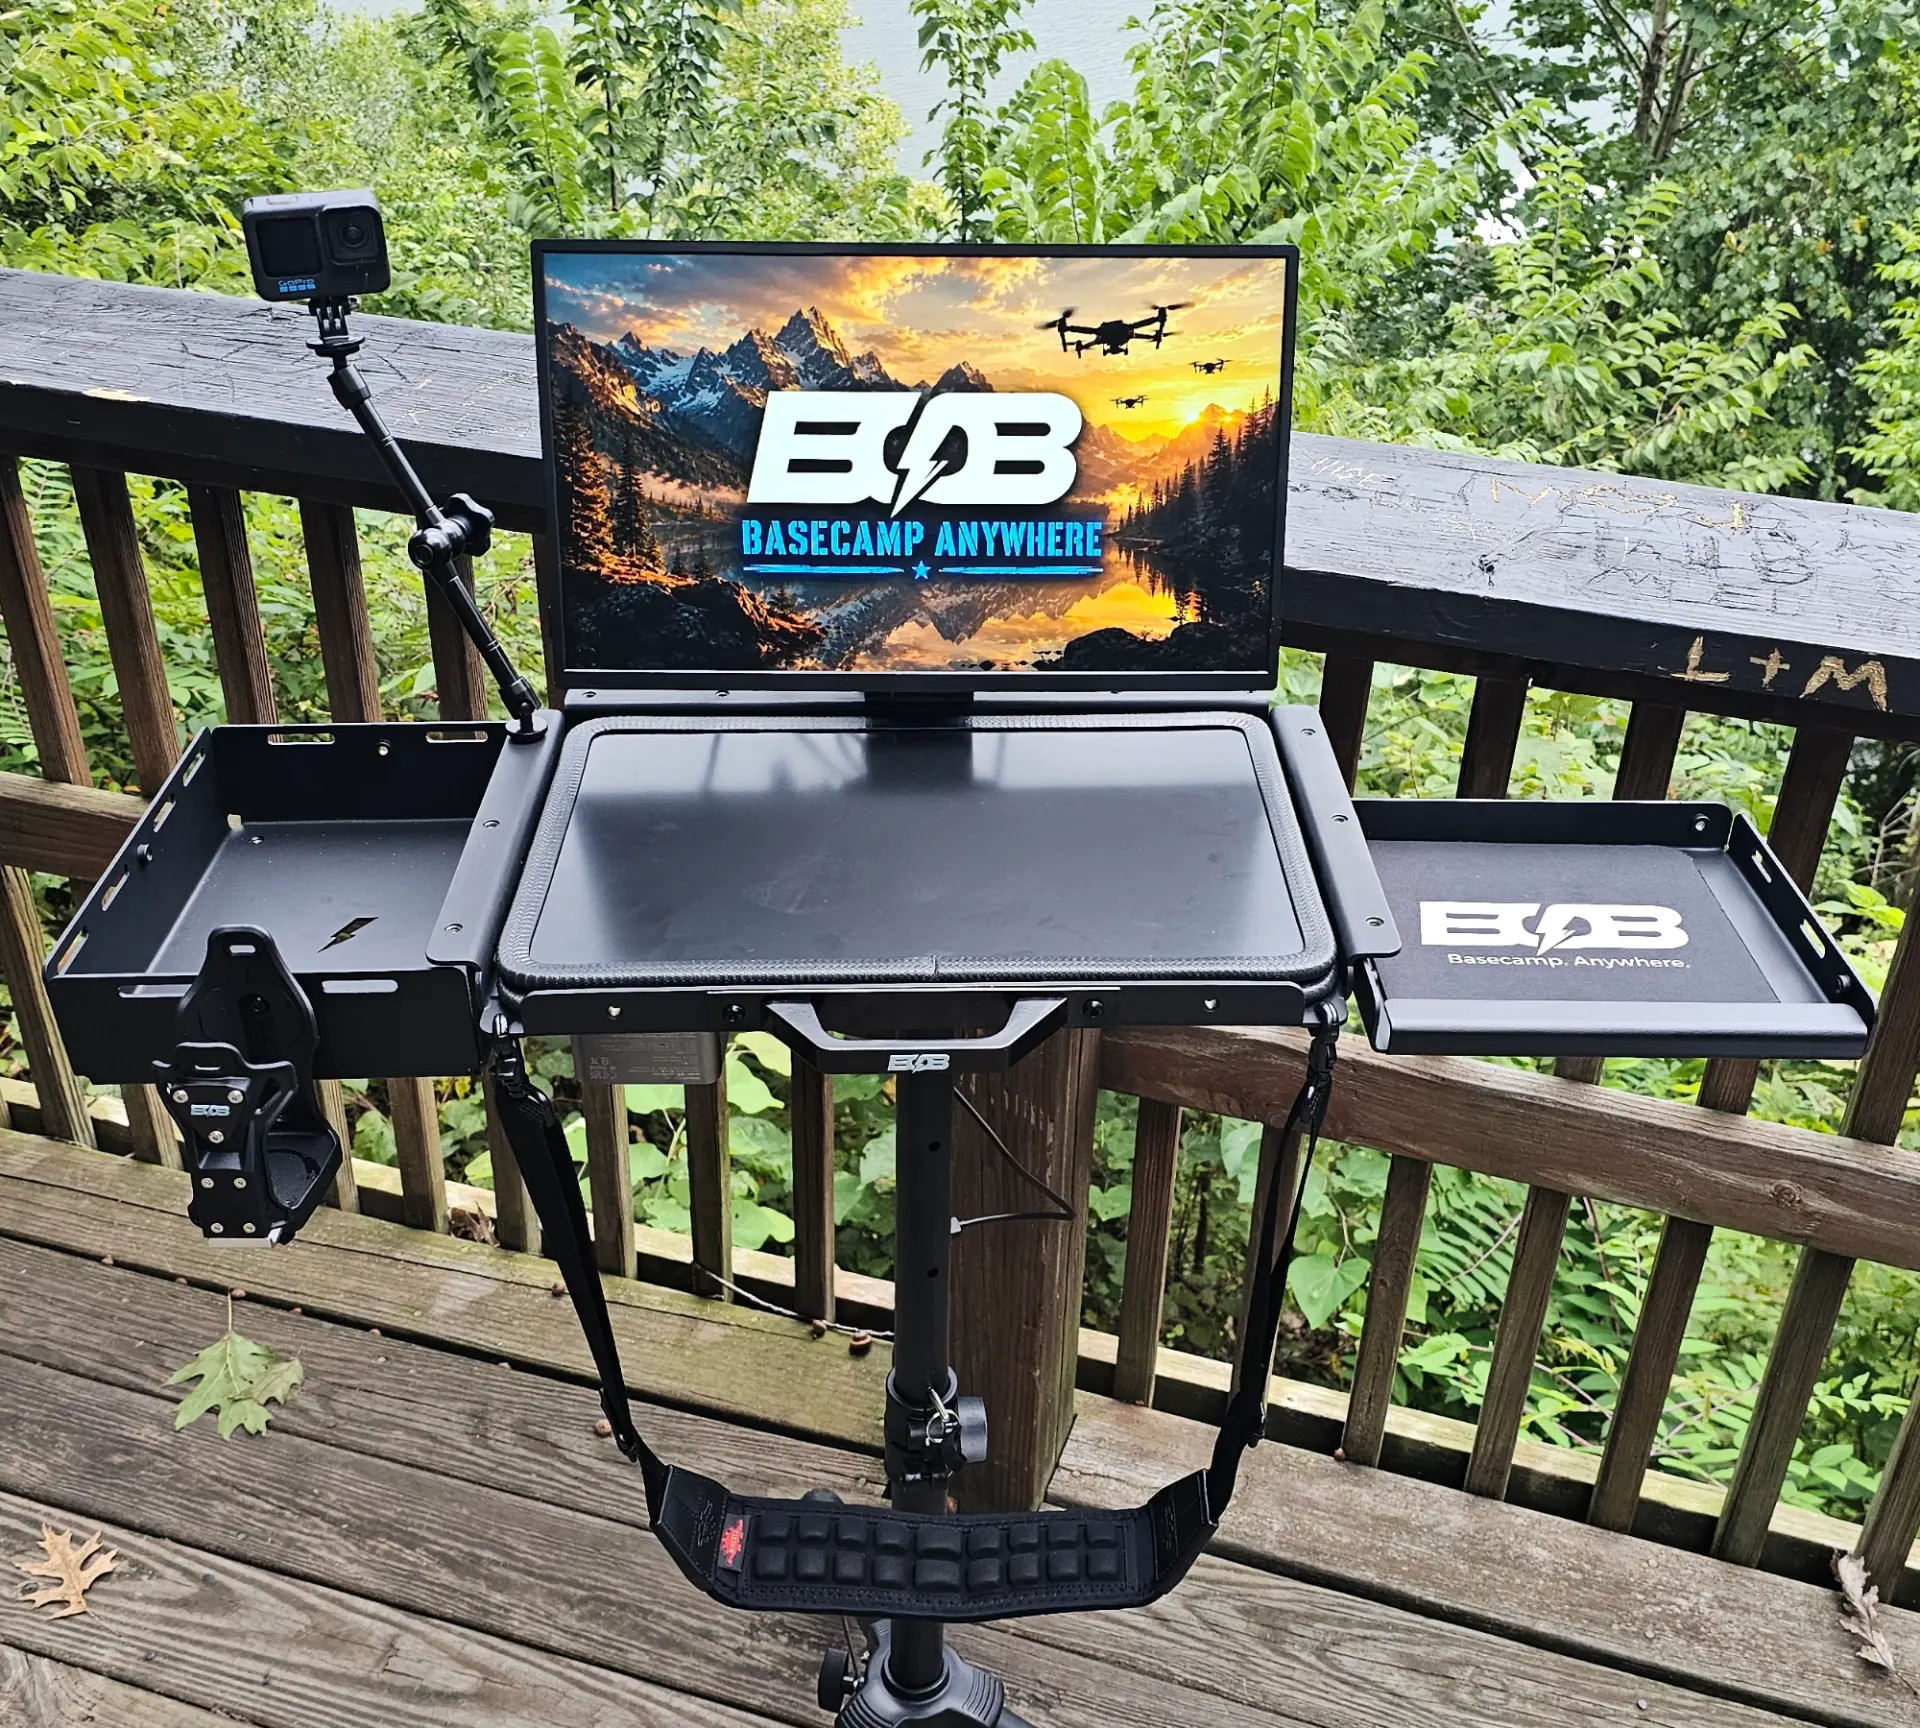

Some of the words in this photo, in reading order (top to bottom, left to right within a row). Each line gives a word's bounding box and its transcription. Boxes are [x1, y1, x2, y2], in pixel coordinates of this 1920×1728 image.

[746, 391, 1083, 518] BOB
[742, 519, 924, 556] BASECAMP
[934, 521, 1103, 557] ANYWHERE
[1670, 636, 1731, 683] L
[1800, 655, 1888, 712] M
[1420, 901, 1690, 956] BOB
[1447, 953, 1568, 968] Basecamp.
[1574, 955, 1691, 969] Anywhere.
[887, 1053, 950, 1074] BOB
[190, 1104, 230, 1117] BOB
